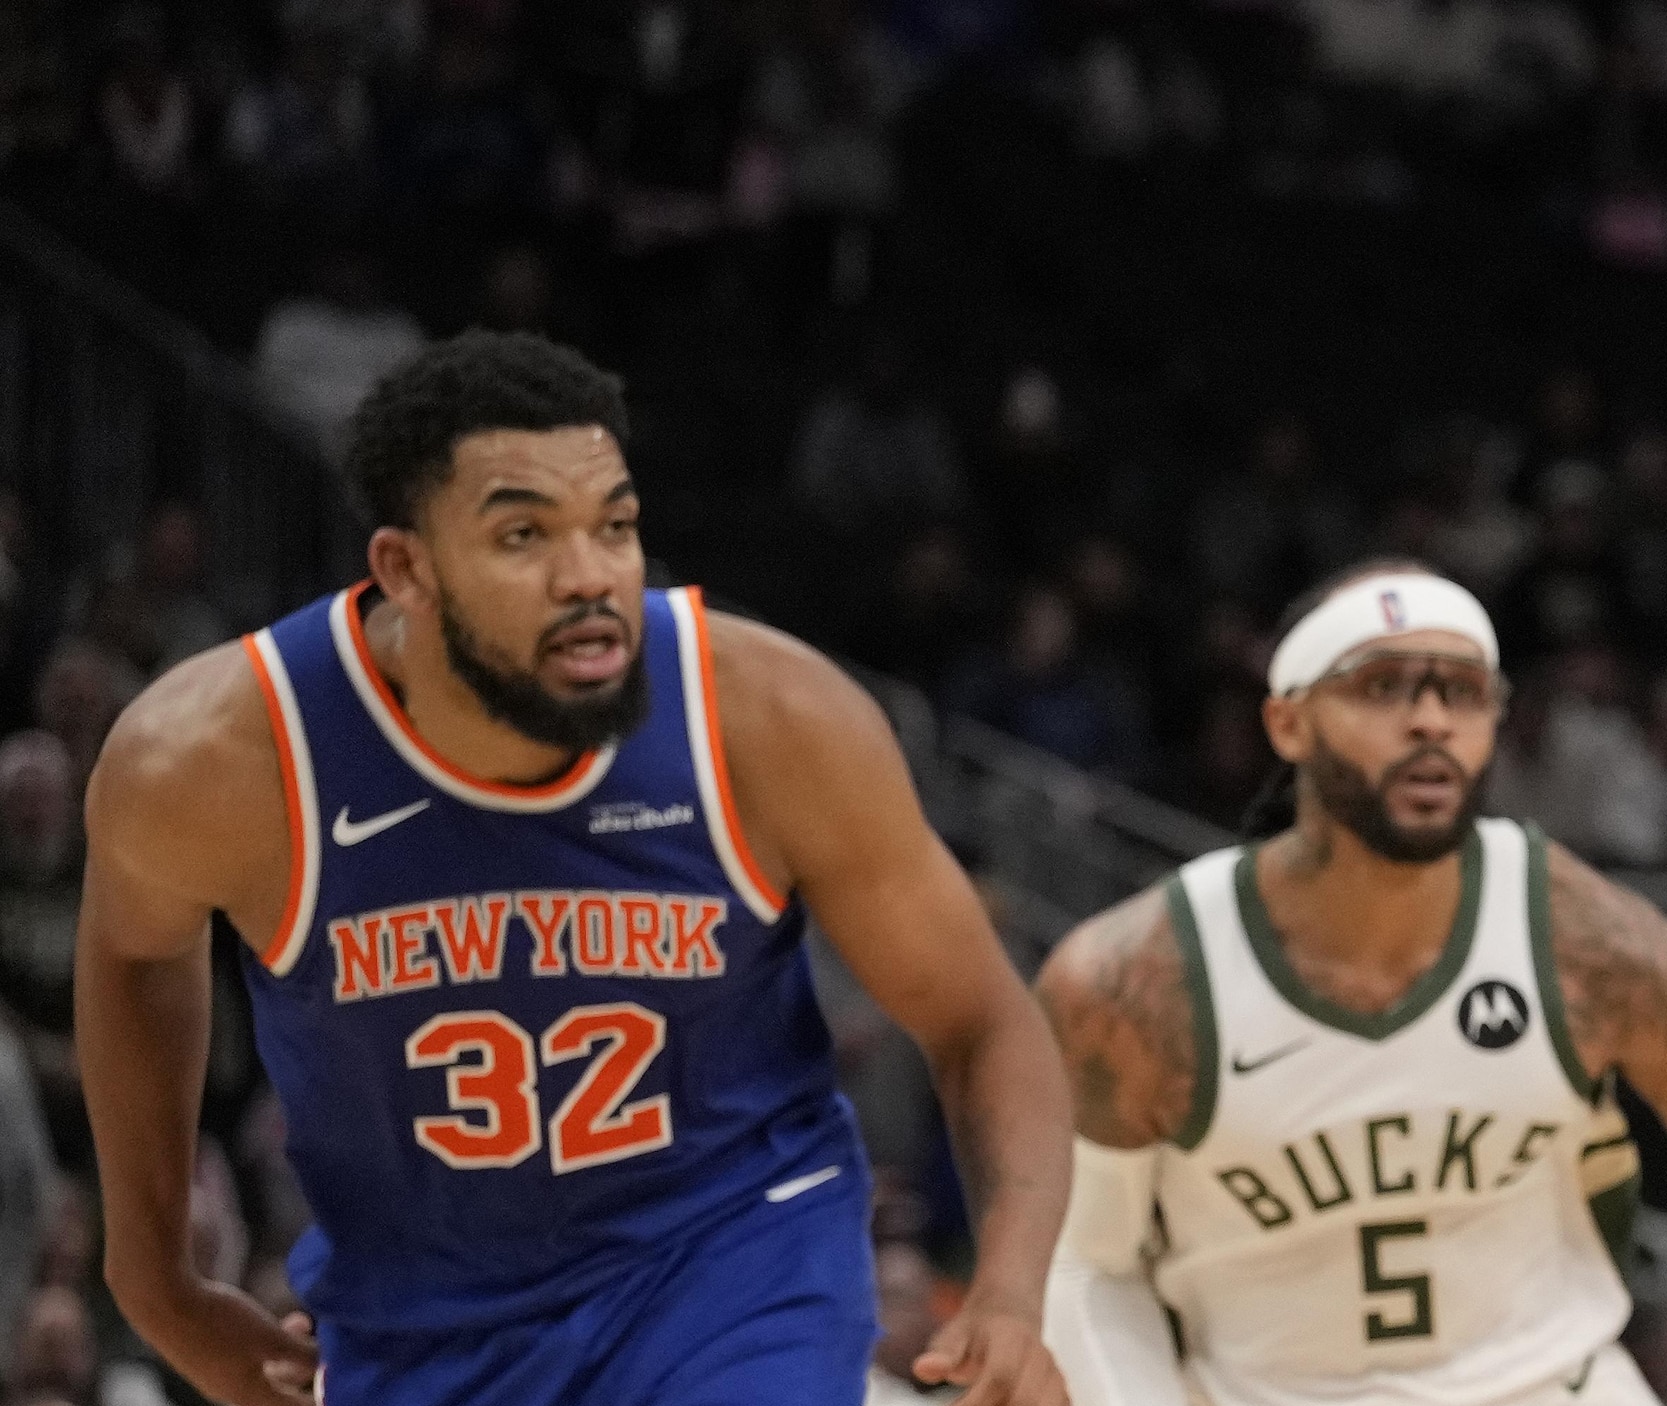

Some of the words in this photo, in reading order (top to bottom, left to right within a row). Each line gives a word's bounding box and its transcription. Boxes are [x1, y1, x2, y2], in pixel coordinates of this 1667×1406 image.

[328, 891, 513, 1003] NEW
[512, 888, 729, 979] YORK
[404, 1001, 674, 1176] 32
[1216, 1111, 1558, 1232] BUCKS
[1357, 1220, 1433, 1343] 5
